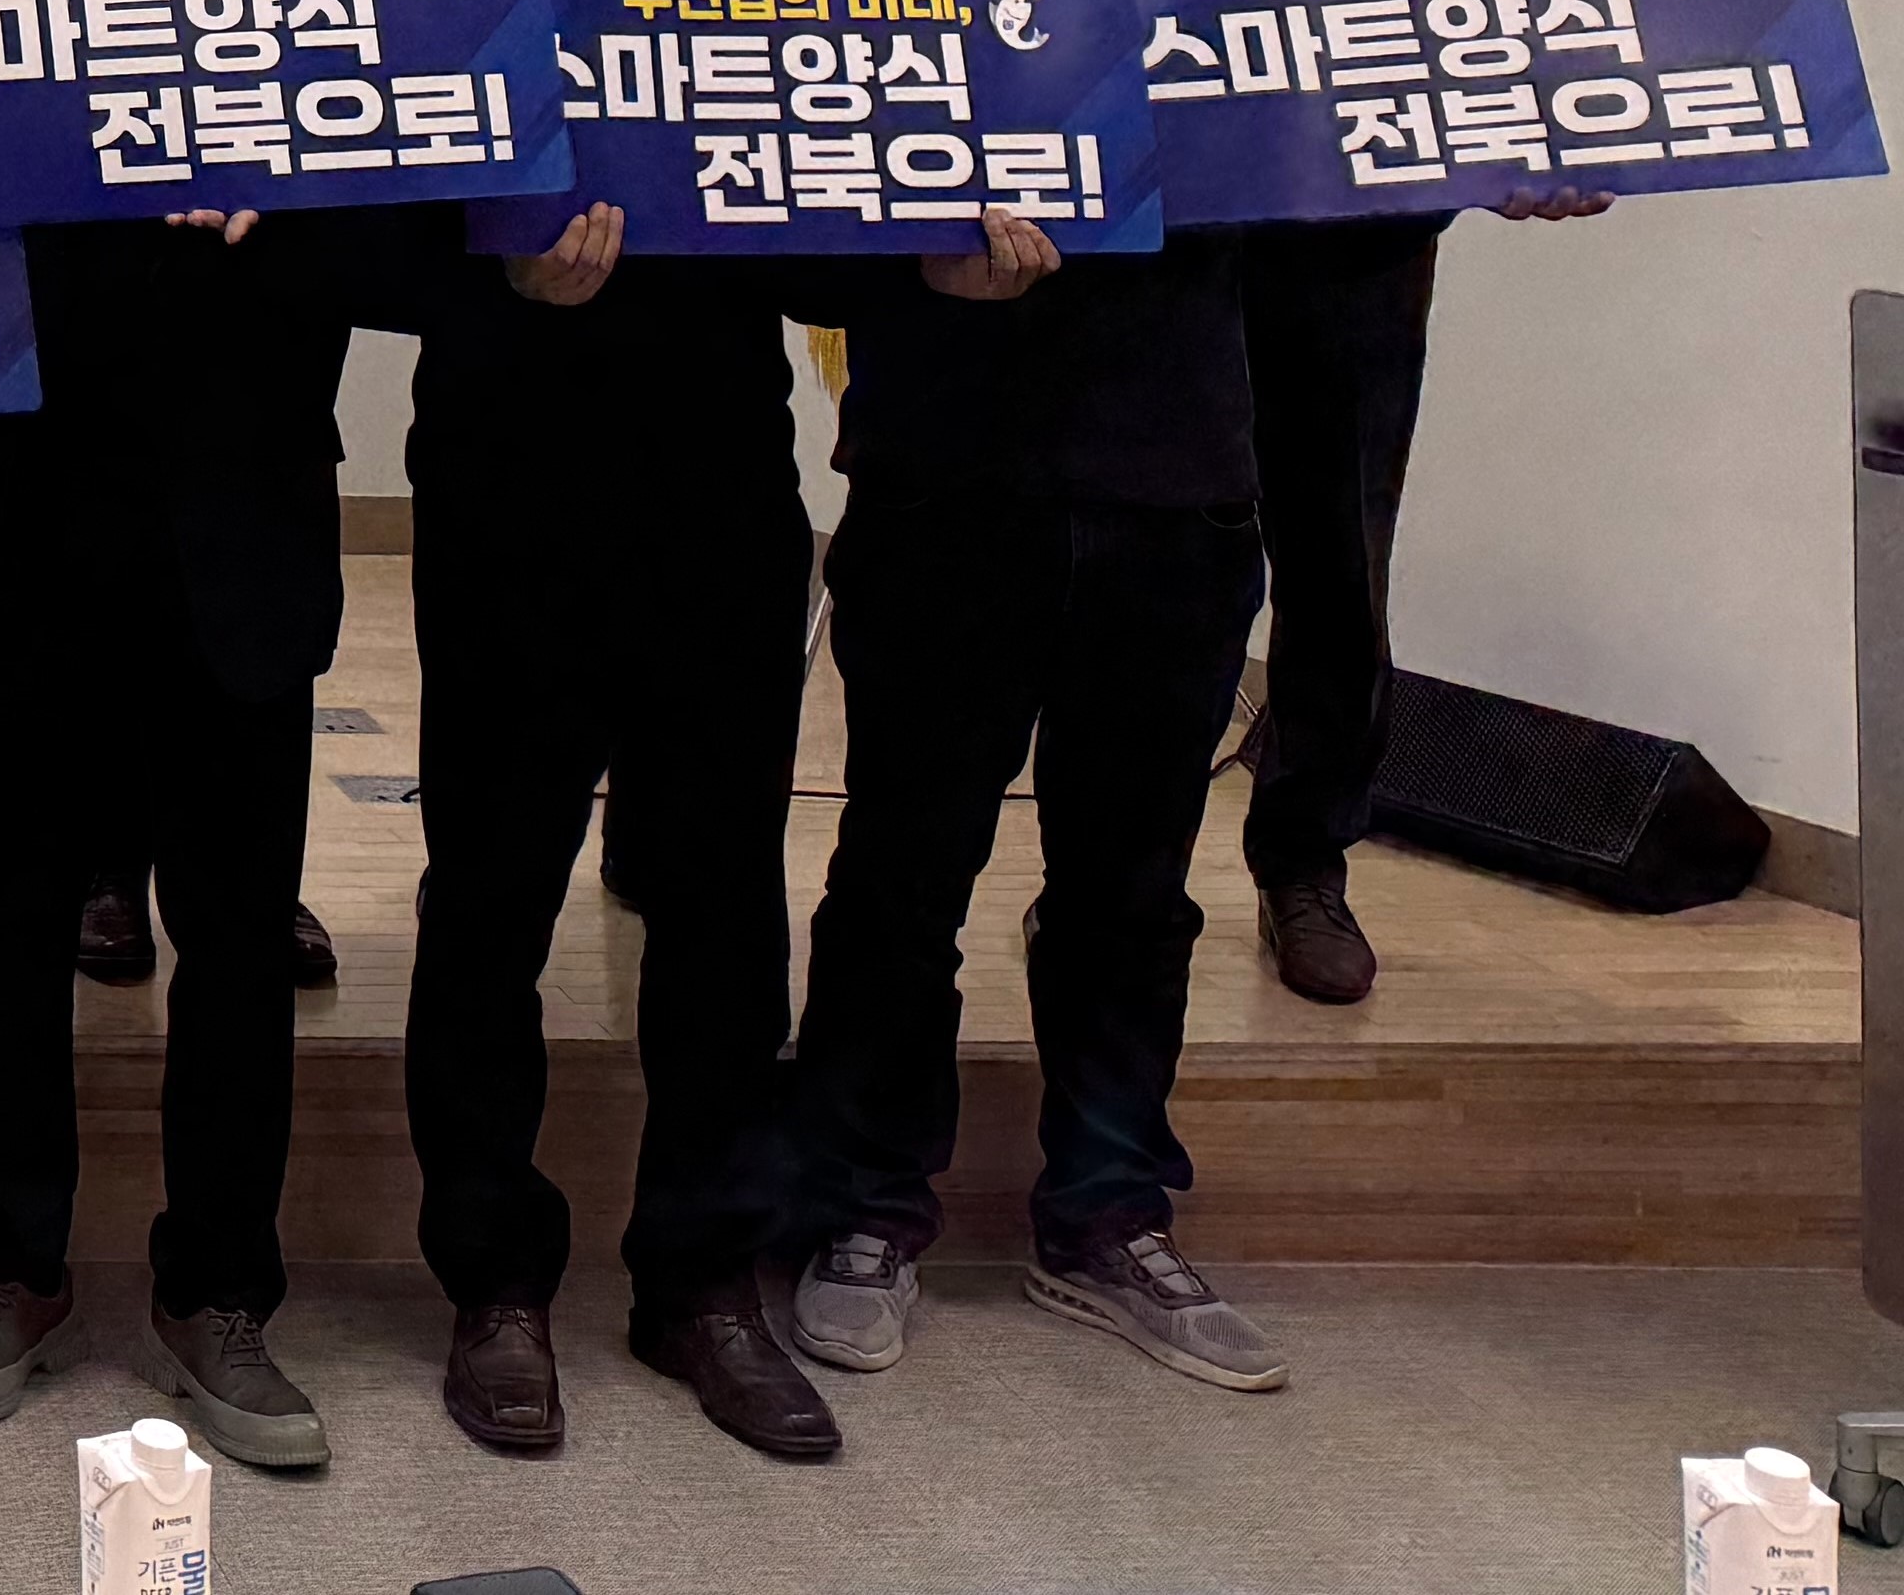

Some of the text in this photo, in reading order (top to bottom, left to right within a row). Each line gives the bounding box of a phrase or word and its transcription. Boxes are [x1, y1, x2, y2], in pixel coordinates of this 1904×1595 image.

[88, 72, 513, 185] 전북으로!
[694, 132, 1105, 223] 전북으로!
[1336, 63, 1812, 188] 전북으로!
